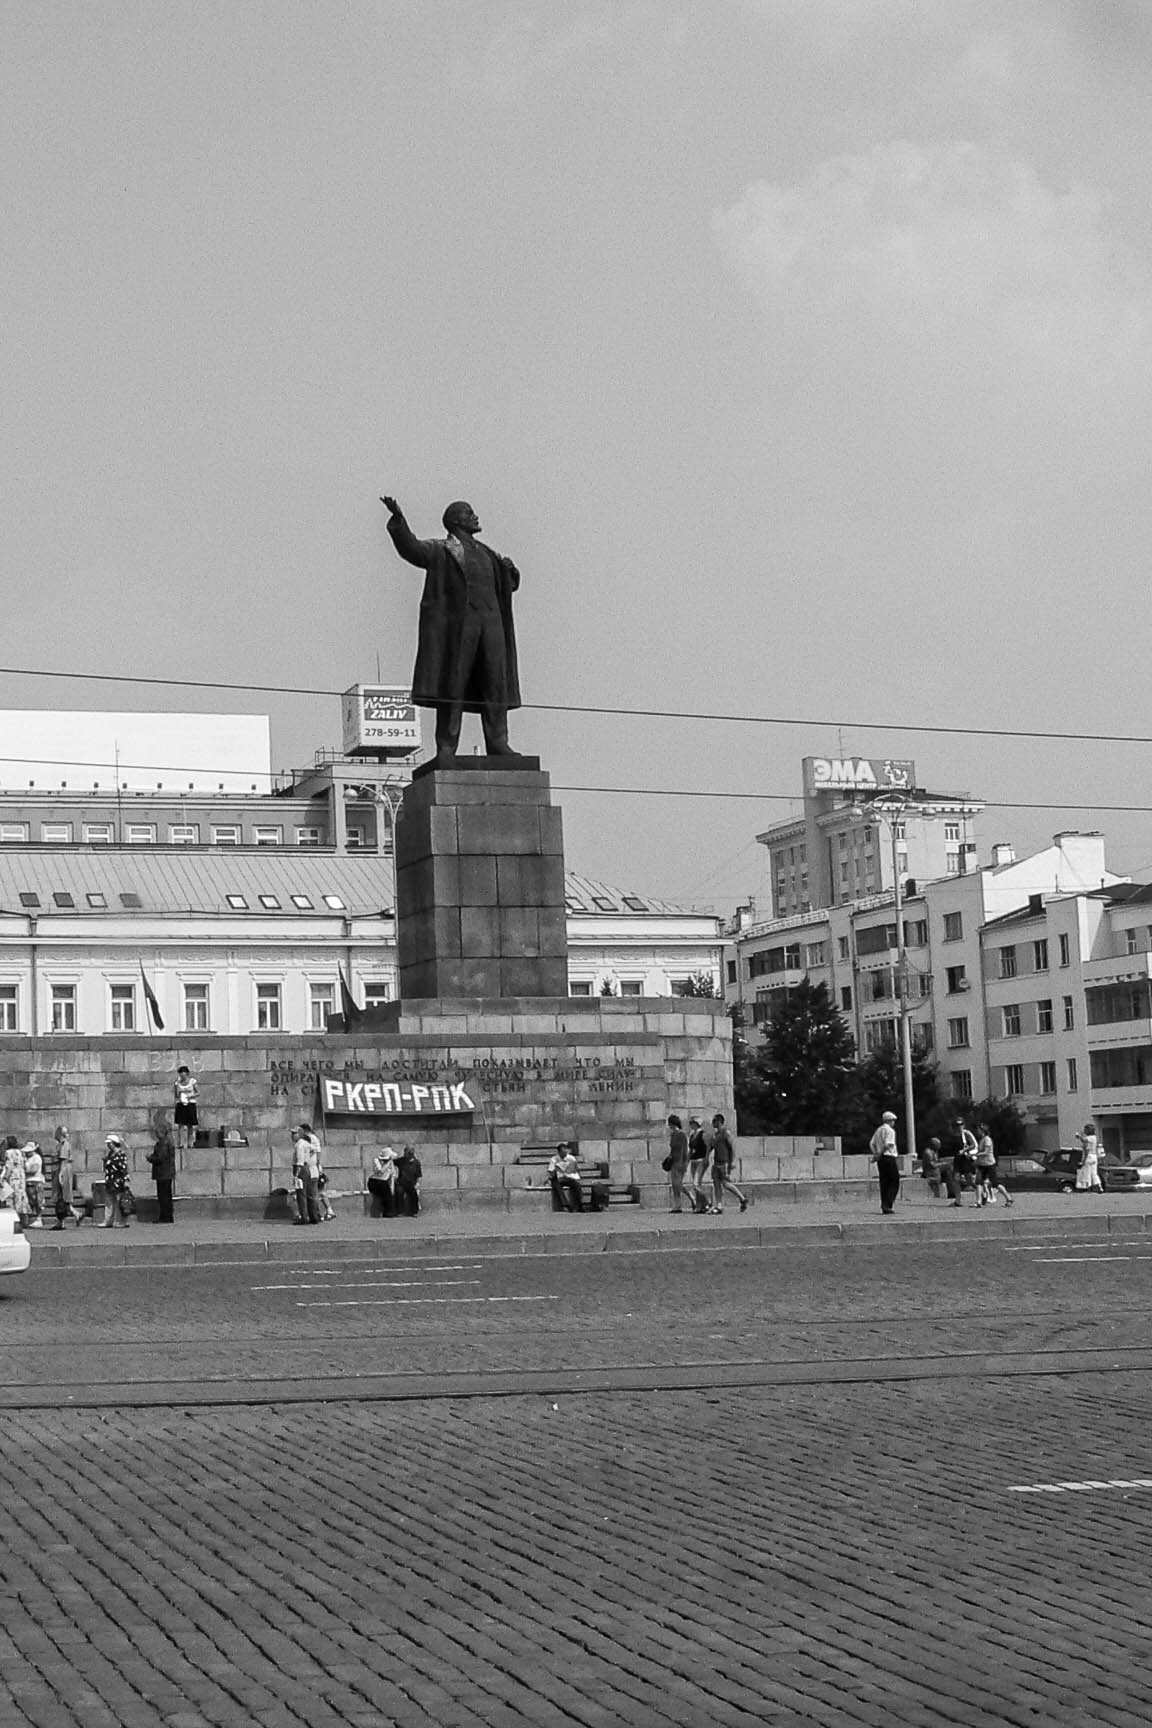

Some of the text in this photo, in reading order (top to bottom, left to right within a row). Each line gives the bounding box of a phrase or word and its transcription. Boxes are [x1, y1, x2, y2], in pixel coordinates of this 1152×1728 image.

[370, 709, 407, 719] ZALIV
[364, 728, 416, 737] 278-59-11
[813, 759, 877, 781] ЭМА
[303, 1060, 334, 1070] ЧЕГО
[344, 1060, 363, 1070] МЫ
[576, 1058, 601, 1068] ЧТО
[615, 1057, 634, 1067] МЫ
[271, 1085, 289, 1096] НА
[325, 1079, 475, 1112] РКРП-РПК
